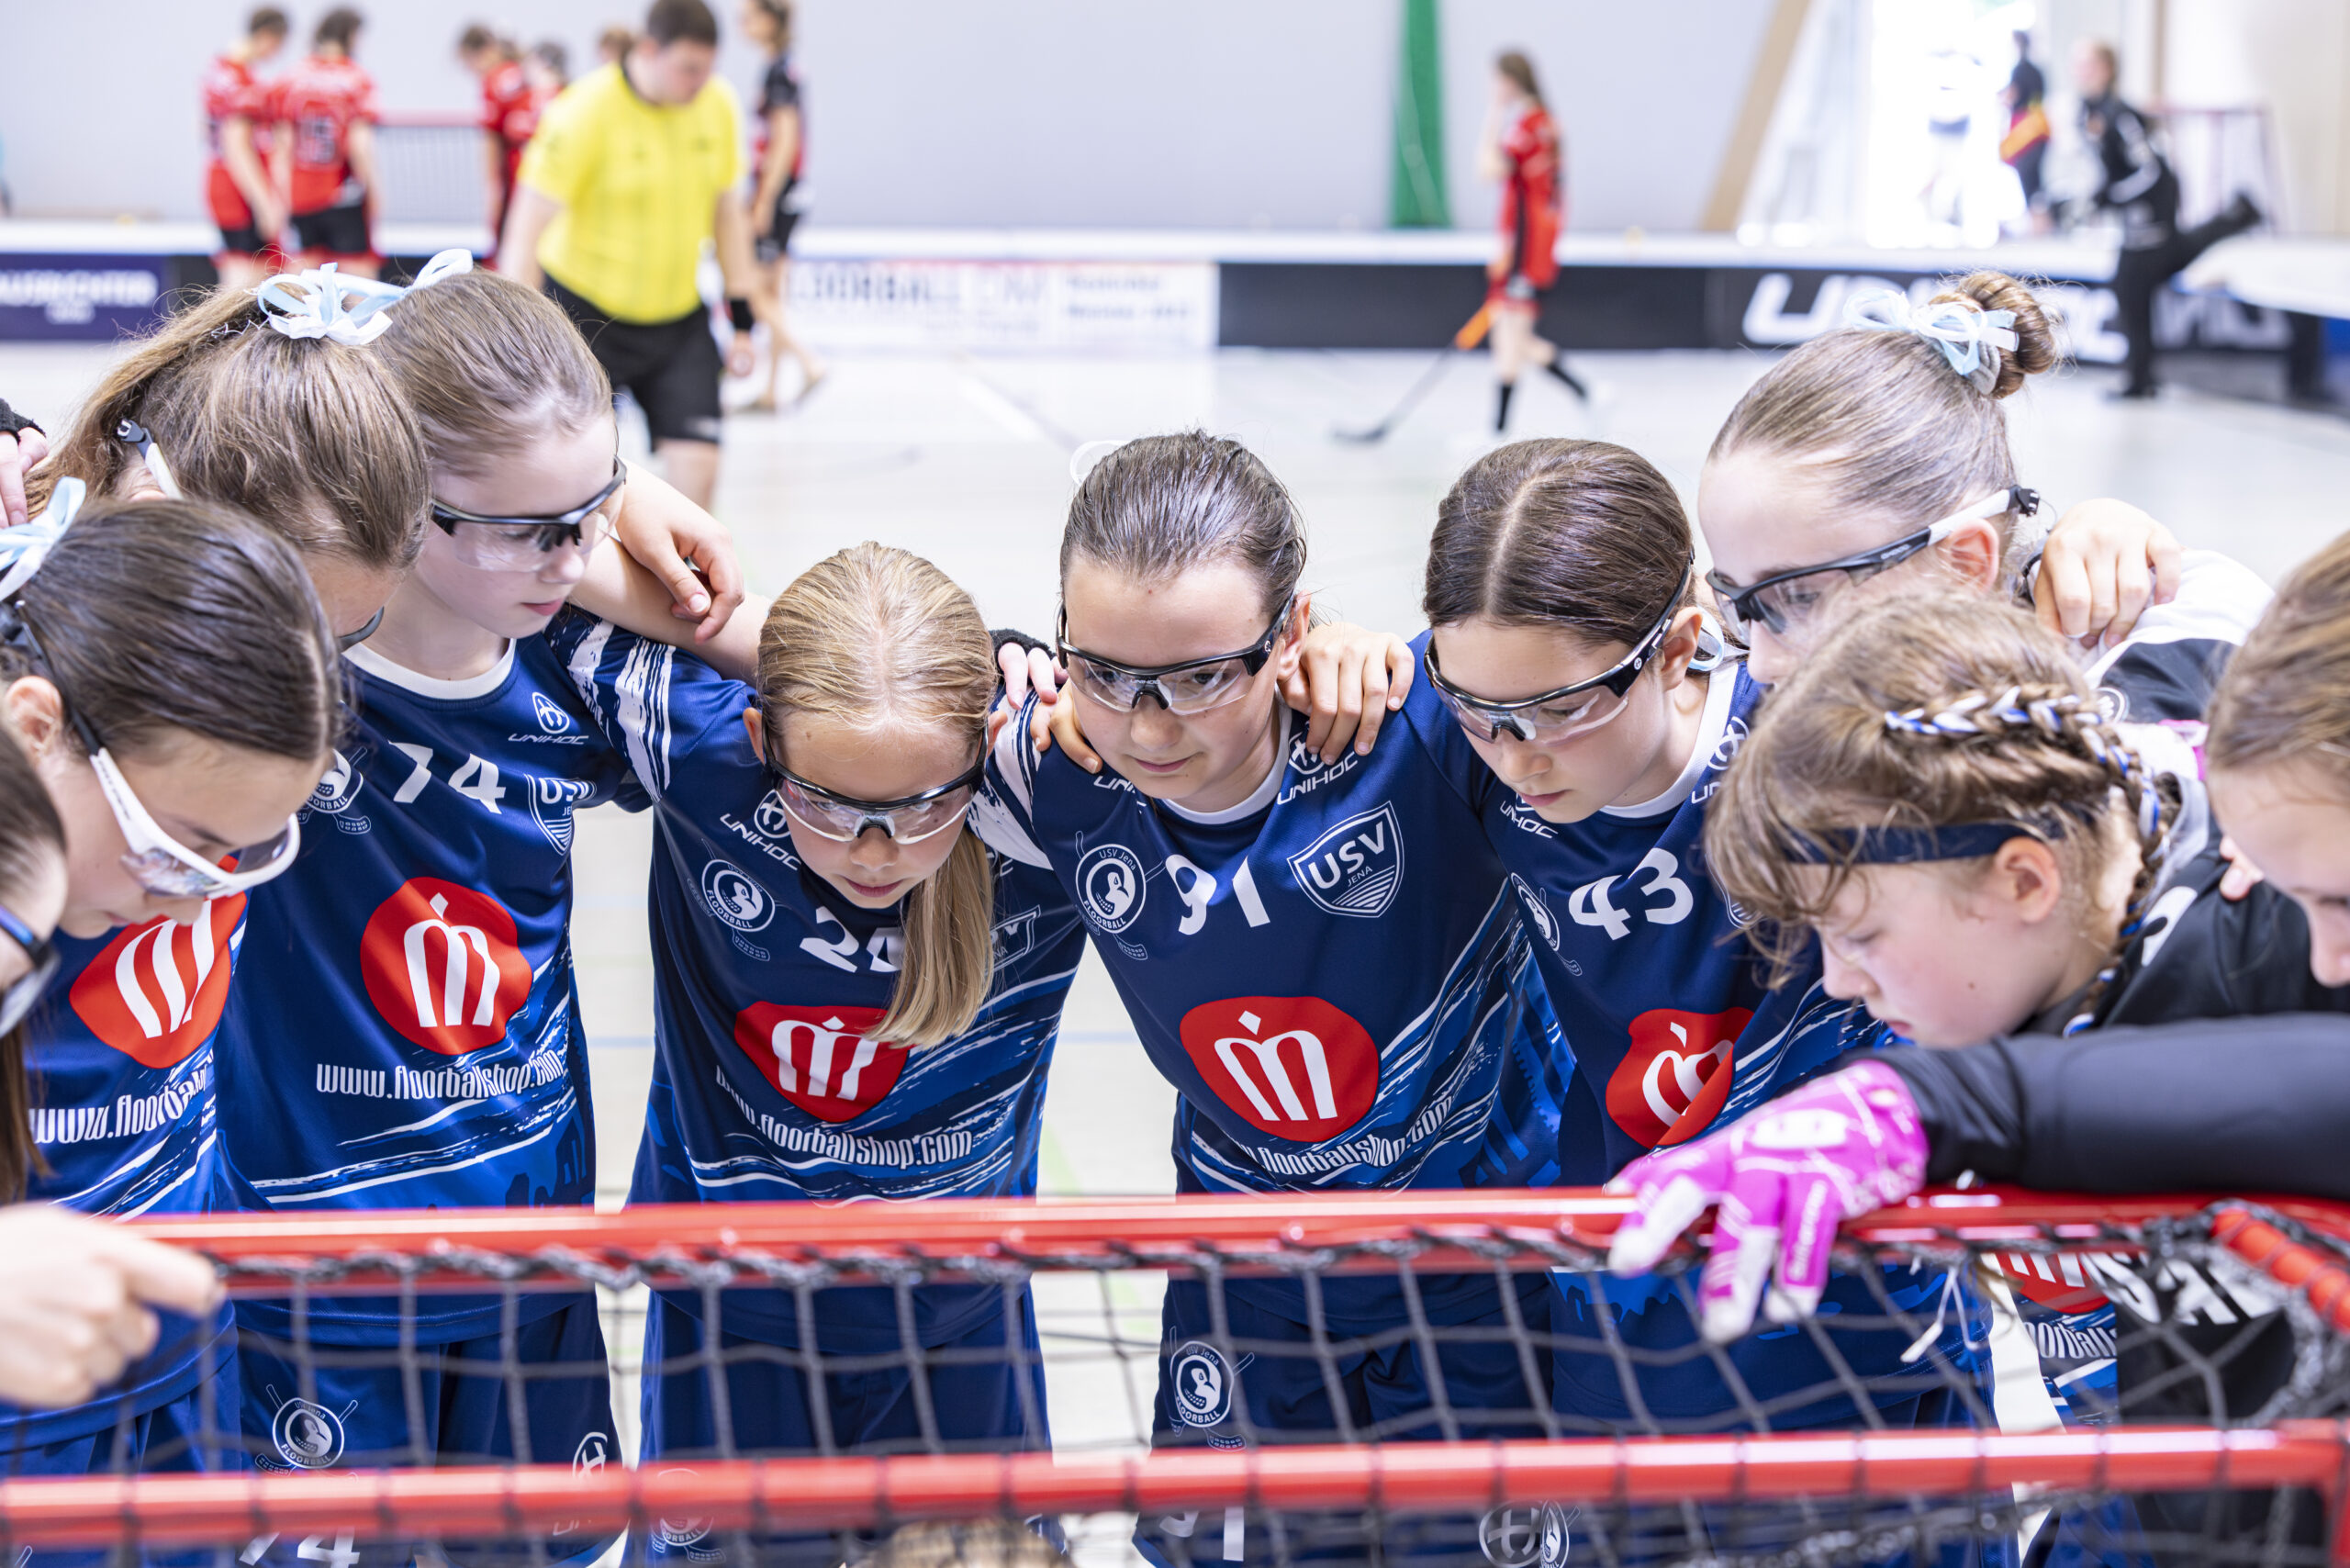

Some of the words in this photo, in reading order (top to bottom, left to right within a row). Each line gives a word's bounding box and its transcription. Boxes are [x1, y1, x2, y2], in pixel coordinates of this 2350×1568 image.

[508, 734, 589, 745] UNIHOC
[387, 739, 506, 814] 74
[1277, 751, 1358, 805] UNIHOC
[720, 813, 801, 871] UNIHOC
[1099, 848, 1118, 859] USV
[1119, 850, 1136, 871] Jena
[1308, 821, 1384, 889] USV
[1165, 854, 1271, 935] 91
[1348, 866, 1373, 887] JENA
[1569, 847, 1694, 941] 43
[707, 890, 754, 929] FLOORBALL
[1083, 900, 1126, 929] FLOORBALL
